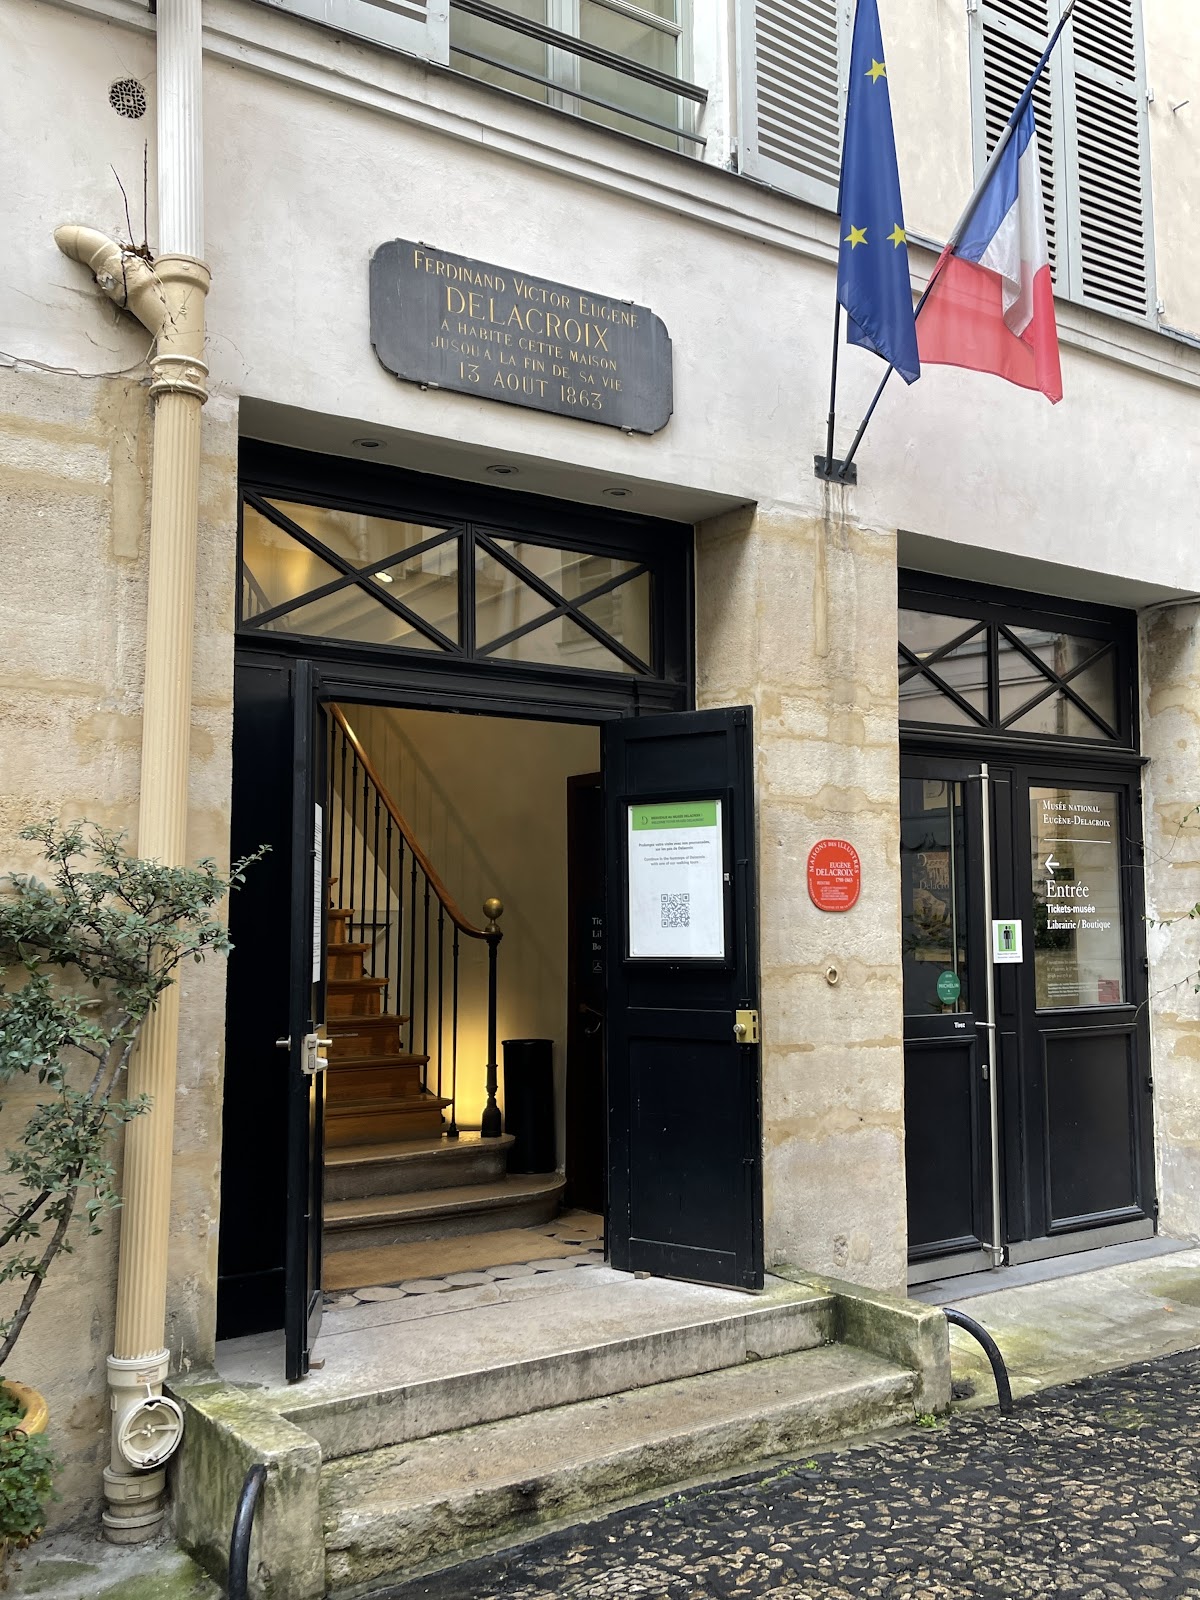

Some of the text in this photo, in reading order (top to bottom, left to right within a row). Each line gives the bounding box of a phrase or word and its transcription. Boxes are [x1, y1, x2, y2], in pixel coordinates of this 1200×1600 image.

[414, 250, 505, 292] FERDINAND
[513, 278, 570, 309] VICTOR
[445, 285, 608, 352] DELACROIX
[441, 319, 617, 371] A HABITE CETTE MAISON
[460, 362, 602, 410] 13 AOUT 1863
[500, 352, 516, 366] LA
[524, 358, 545, 372] FIN
[552, 364, 570, 379] DE
[580, 371, 595, 385] SA
[602, 376, 622, 392] VIE
[1043, 800, 1100, 813] MUSÉE NATIONAL
[816, 868, 854, 876] DELACROIX
[1046, 880, 1089, 898] Entrée
[1046, 904, 1095, 913] Tickets-musée
[1047, 920, 1076, 929] Librairie
[1082, 920, 1111, 931] Boutique
